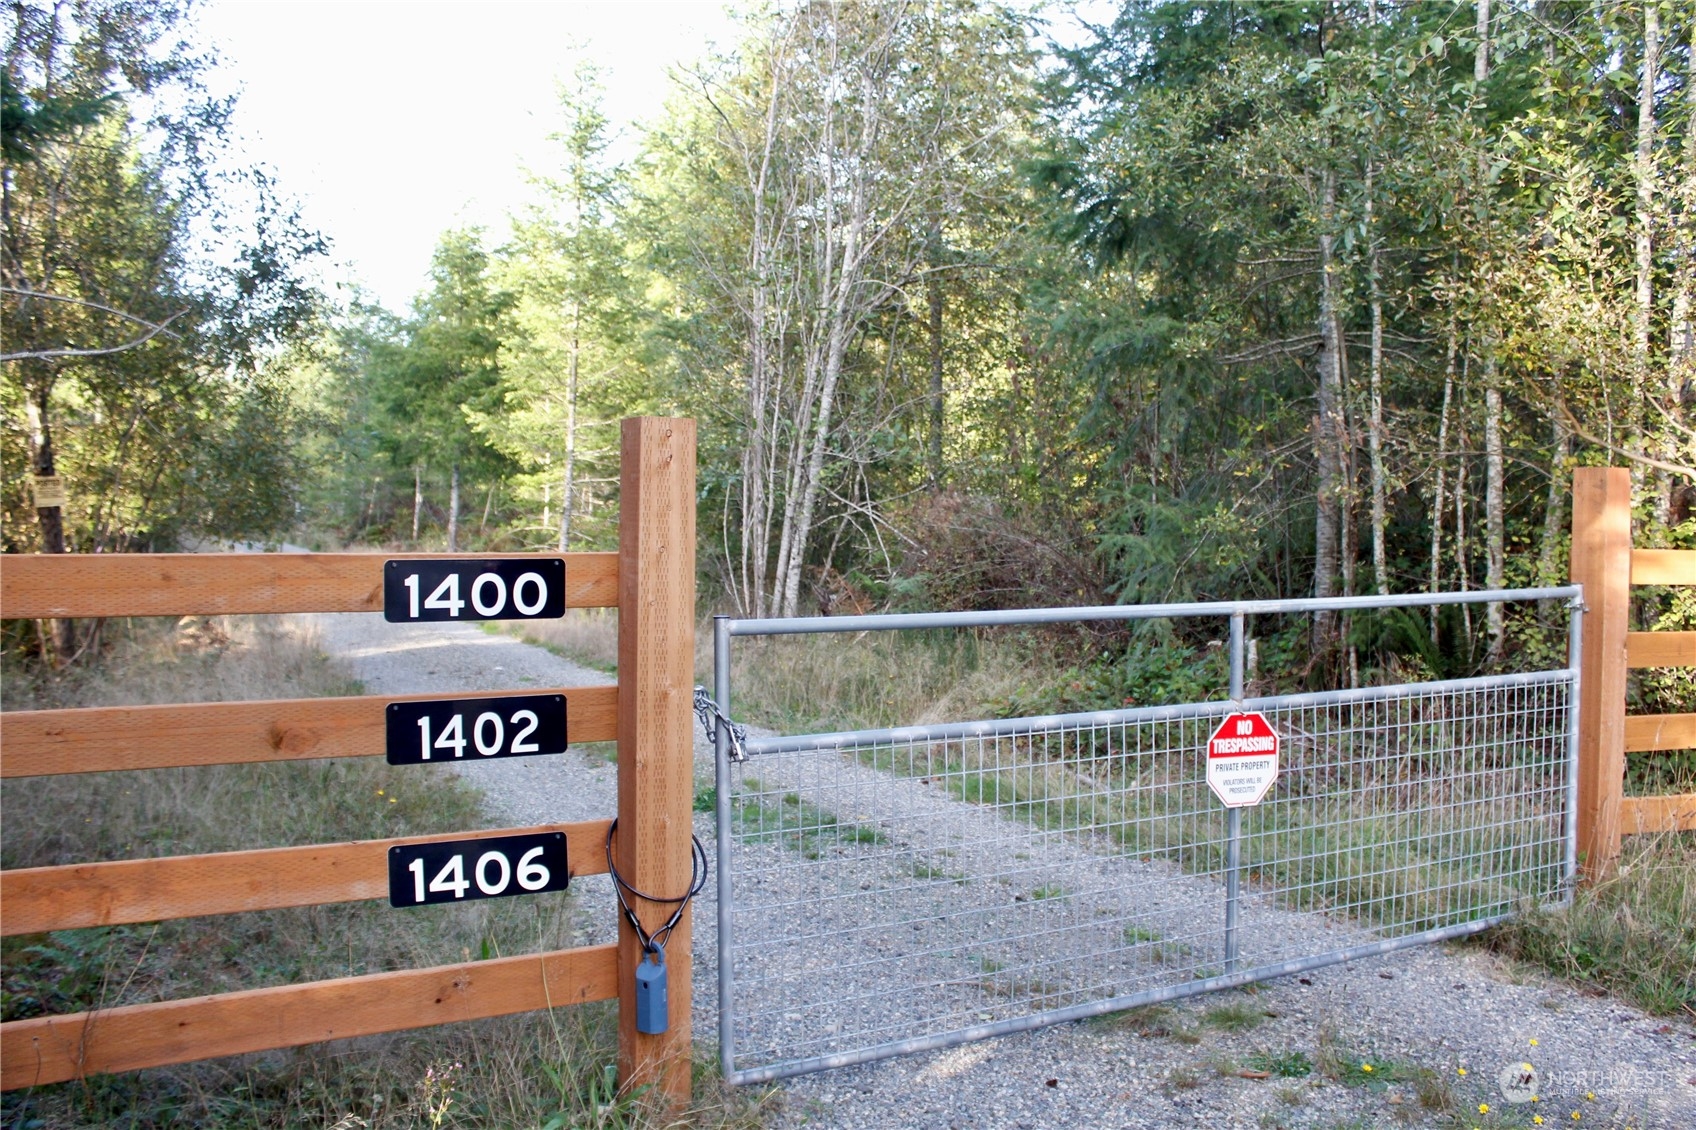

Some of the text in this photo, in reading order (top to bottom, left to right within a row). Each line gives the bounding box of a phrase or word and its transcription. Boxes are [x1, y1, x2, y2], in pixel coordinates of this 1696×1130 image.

[404, 572, 548, 618] 1400
[417, 710, 539, 760] 1402
[1236, 719, 1253, 736] NO
[1212, 736, 1275, 754] TRESPASSING
[1215, 761, 1270, 772] PRIVATE PROPERTY
[1223, 778, 1246, 786] VIOLATORS
[1229, 786, 1256, 794] PROSECUTED
[409, 847, 550, 902] 1406
